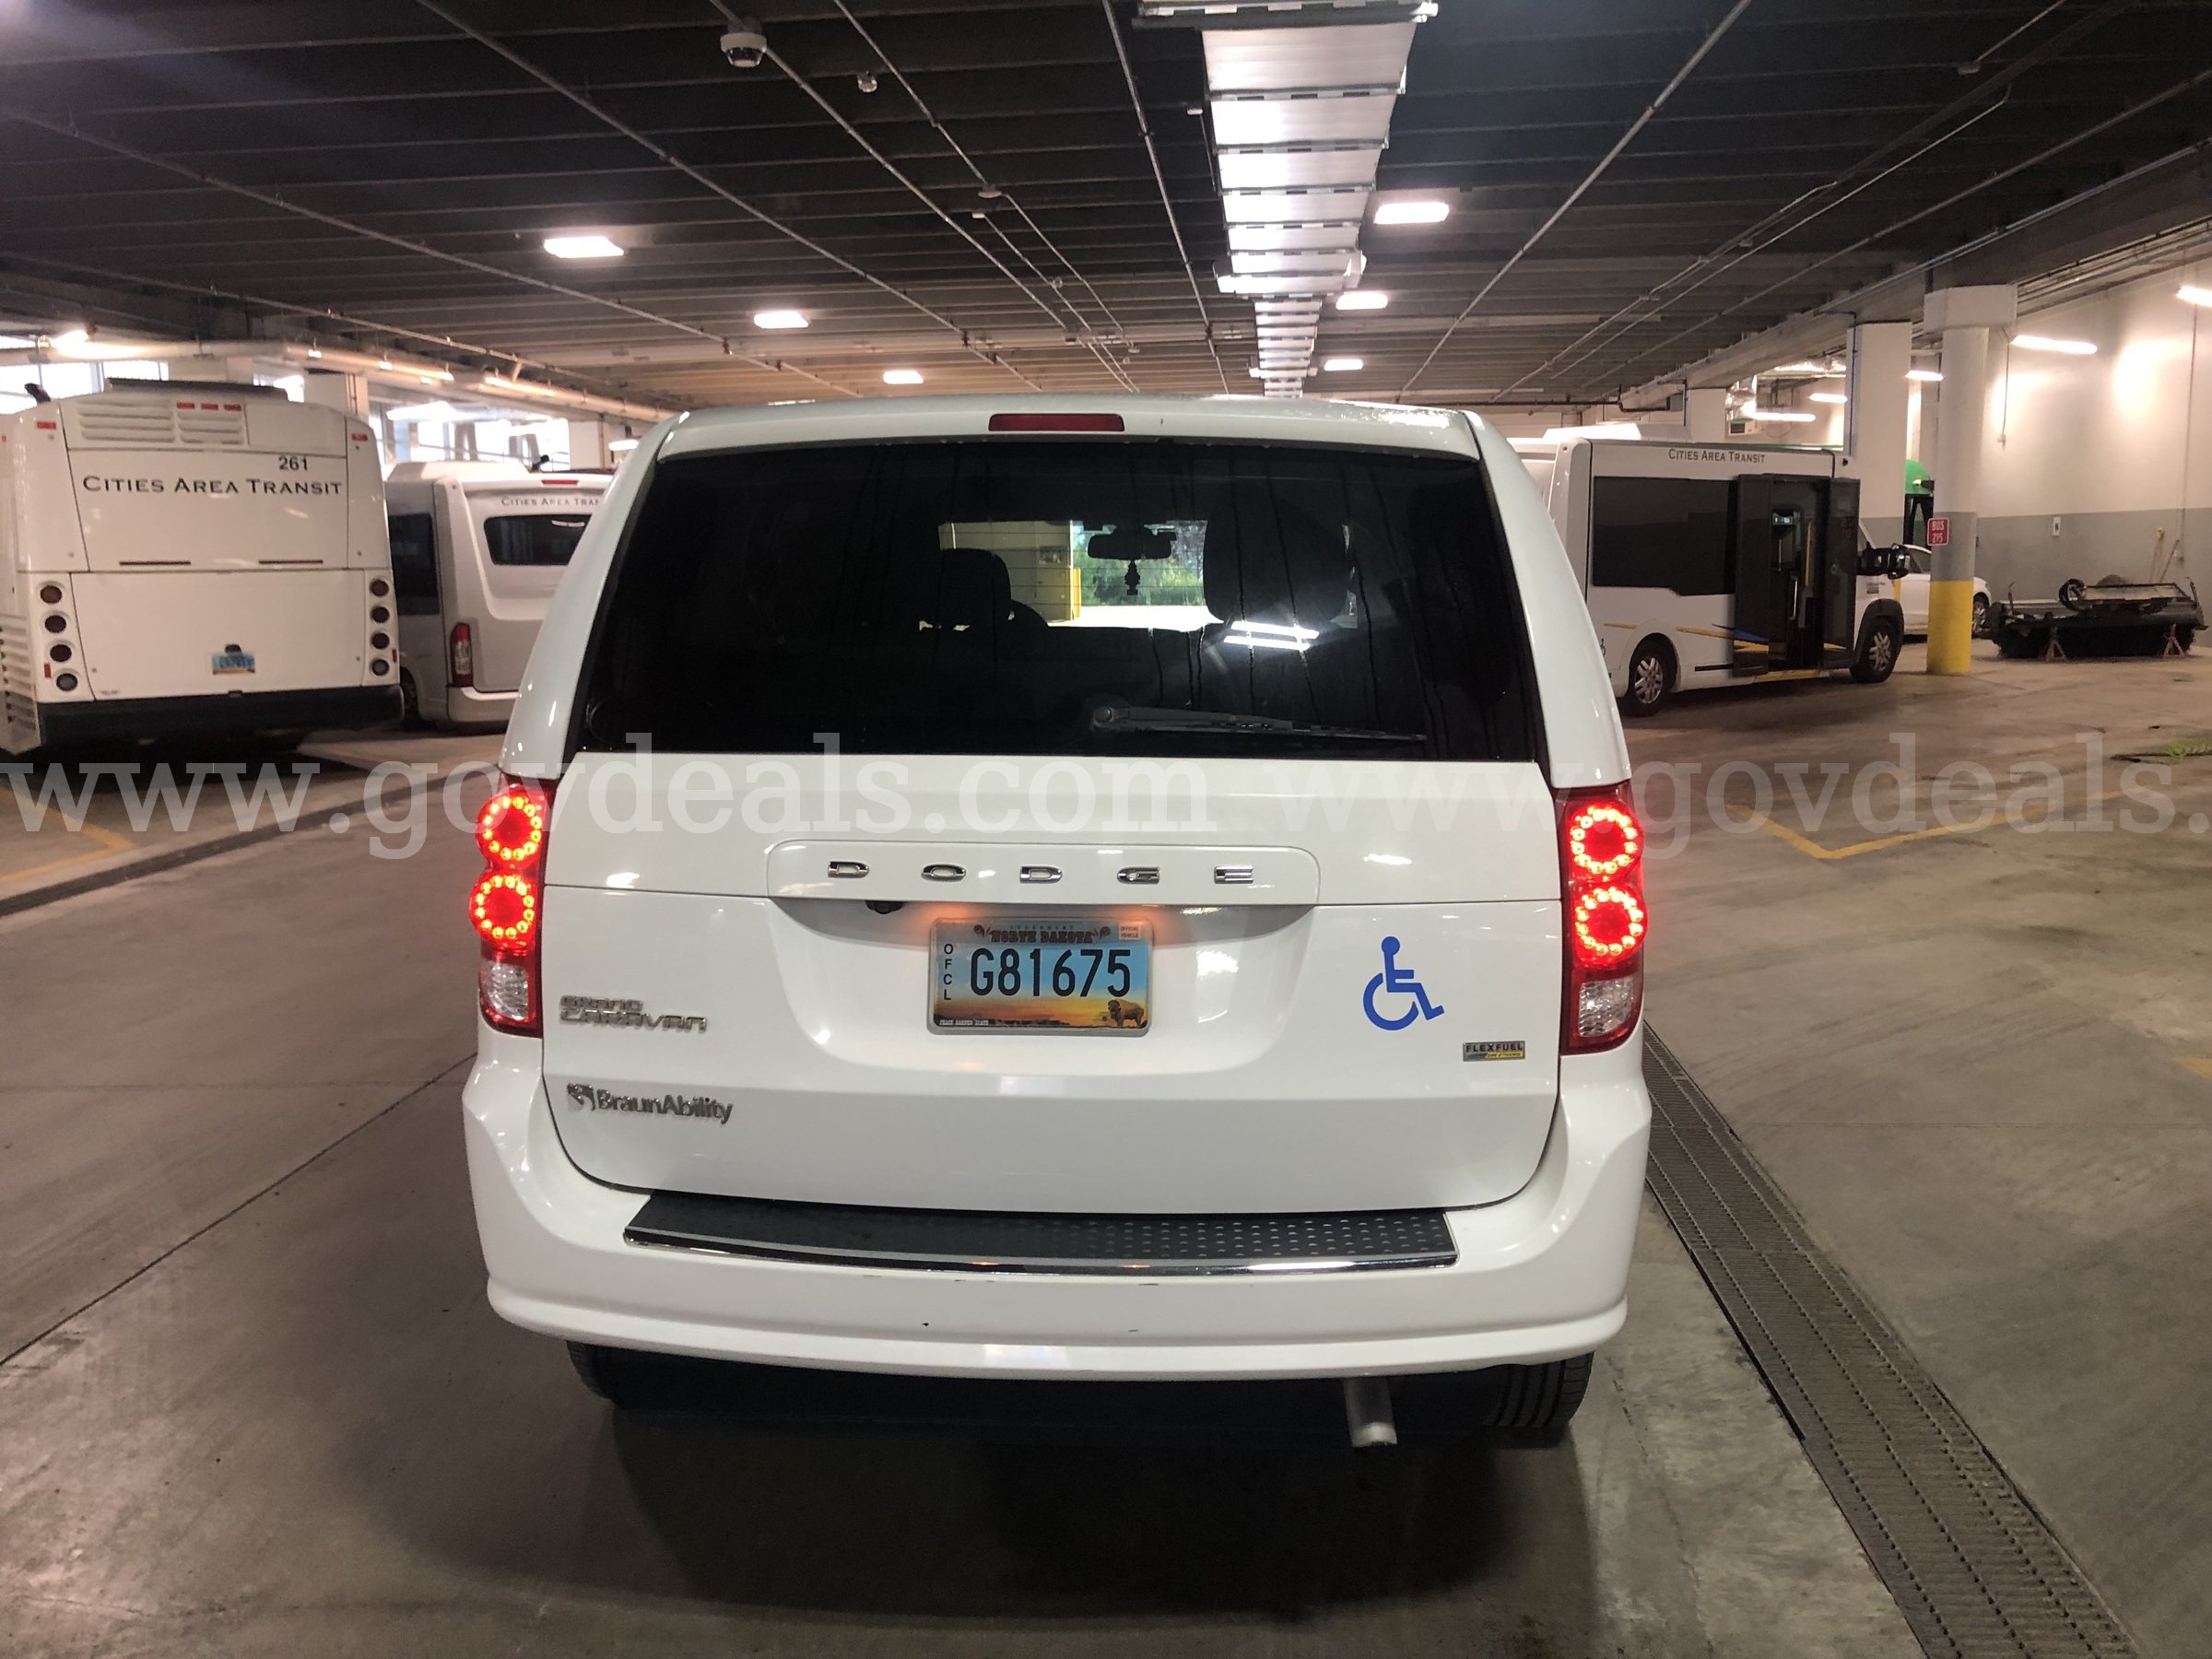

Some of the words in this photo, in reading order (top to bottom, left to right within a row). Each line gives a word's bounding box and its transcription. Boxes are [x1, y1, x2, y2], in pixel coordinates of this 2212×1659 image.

[278, 456, 308, 471] 261
[1669, 448, 1699, 460] CITIES
[1701, 450, 1725, 462] AREA
[1729, 451, 1765, 464] TRANSIT
[83, 476, 164, 492] CITIES
[174, 478, 239, 494] AREA
[245, 478, 342, 495] TRANSIT
[828, 861, 1254, 885] DODGE
[990, 931, 1037, 943] NORTH
[1040, 931, 1093, 944] DAKOTA
[970, 947, 1132, 998] G81675
[596, 1088, 734, 1124] BraunAbility
